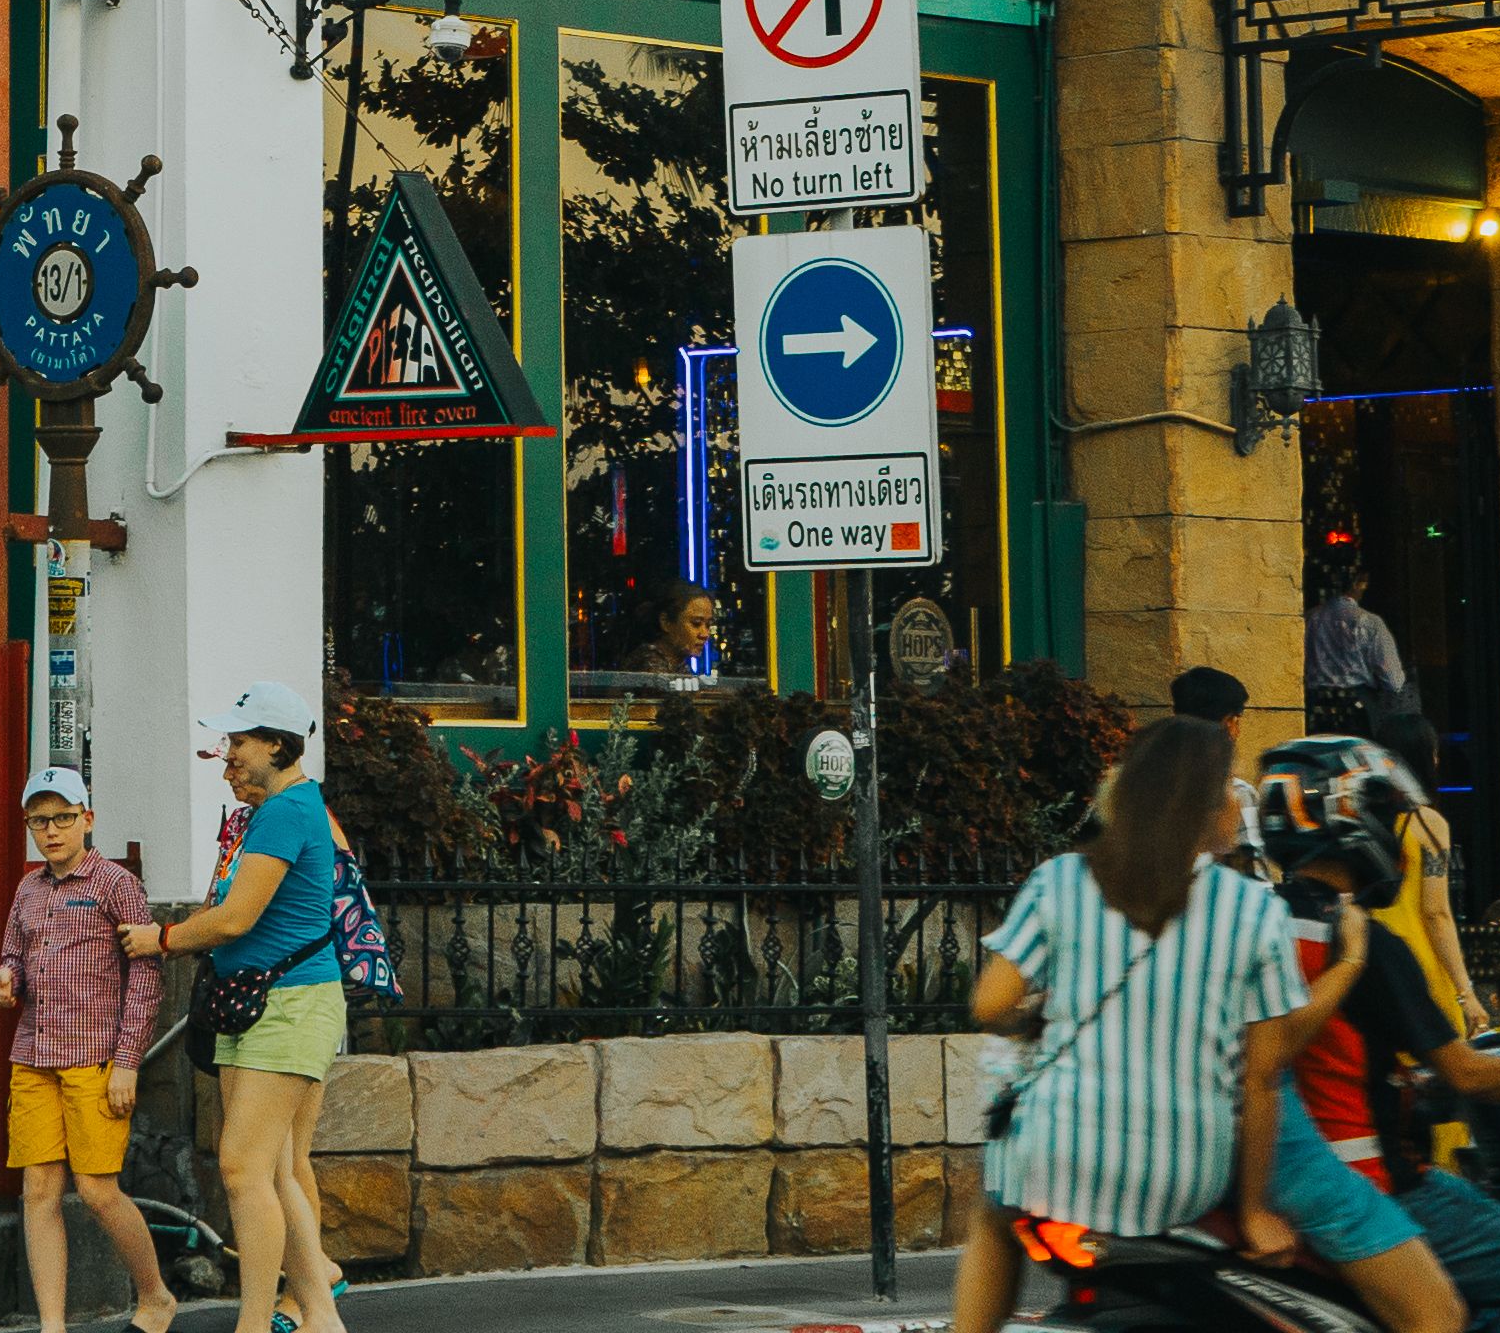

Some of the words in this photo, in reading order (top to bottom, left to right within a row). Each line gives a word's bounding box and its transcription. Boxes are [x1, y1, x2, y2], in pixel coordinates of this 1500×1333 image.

[739, 105, 904, 163] ห้ามเลี้ยวซ้าย
[751, 171, 785, 200] No
[792, 170, 843, 197] turn
[852, 161, 894, 192] left
[11, 202, 111, 259] พัทยา
[40, 261, 84, 304] 13/1
[24, 312, 105, 349] PATTAYA
[324, 235, 394, 395] original
[404, 235, 485, 393] neapolitan
[367, 302, 441, 385] PIZZA
[328, 405, 394, 427] ancient
[399, 401, 428, 426] fire
[433, 403, 478, 424] oven
[752, 464, 923, 512] เดินรถทางเดียว
[787, 520, 834, 548] One
[840, 523, 887, 553] way
[902, 632, 945, 660] HOPS
